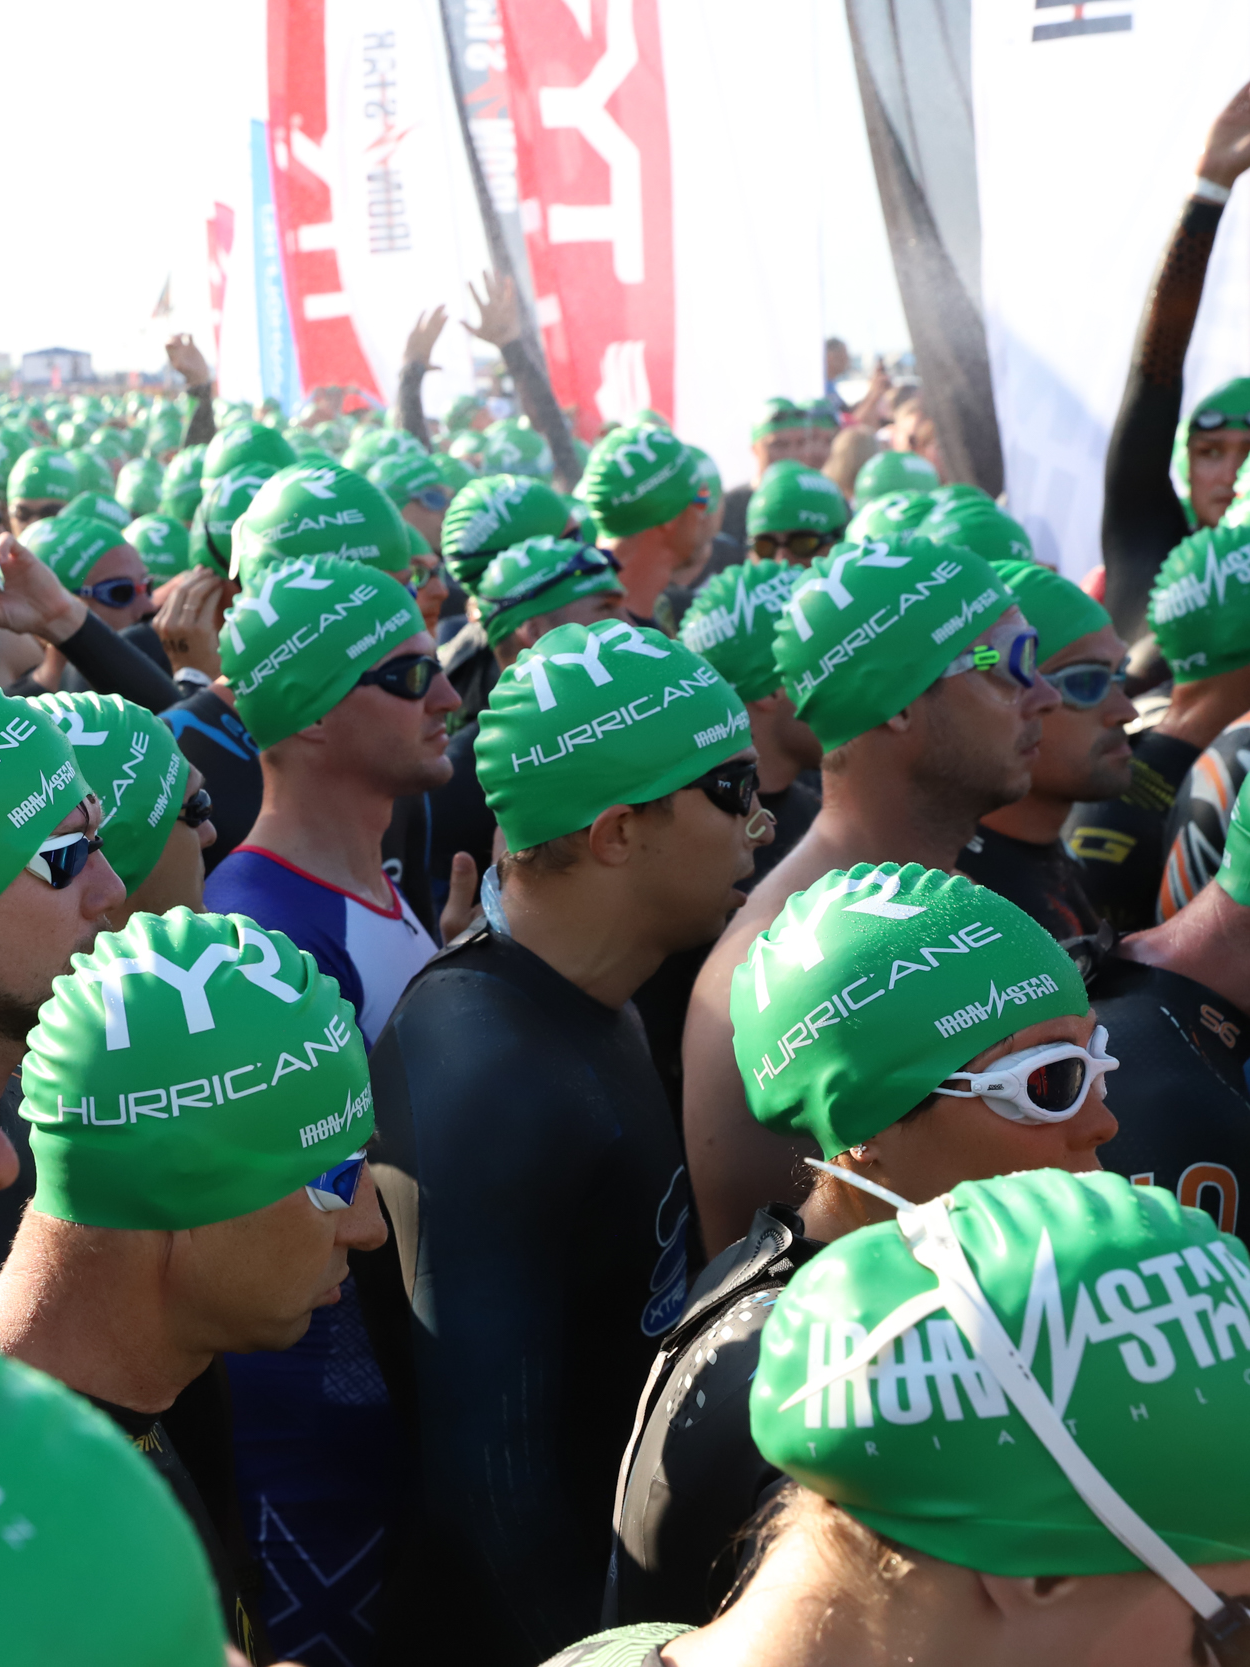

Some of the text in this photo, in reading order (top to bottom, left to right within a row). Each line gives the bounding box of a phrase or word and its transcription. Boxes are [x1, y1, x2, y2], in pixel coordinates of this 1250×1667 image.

[781, 539, 913, 643] TYR
[793, 560, 963, 697] HURRICANE
[513, 622, 672, 713] TYR
[510, 665, 719, 773] HURRICANE
[693, 722, 728, 749] IRON
[6, 760, 77, 830] IRON STAR
[146, 792, 169, 829] IRON
[717, 779, 732, 789] TYR
[76, 927, 304, 1051] TYR
[752, 921, 1004, 1092] HURRICANE
[933, 972, 1060, 1039] IRON STAR
[56, 1013, 352, 1126] HURRICANE
[298, 1111, 344, 1149] IRON
[804, 1318, 1011, 1430] IRON
